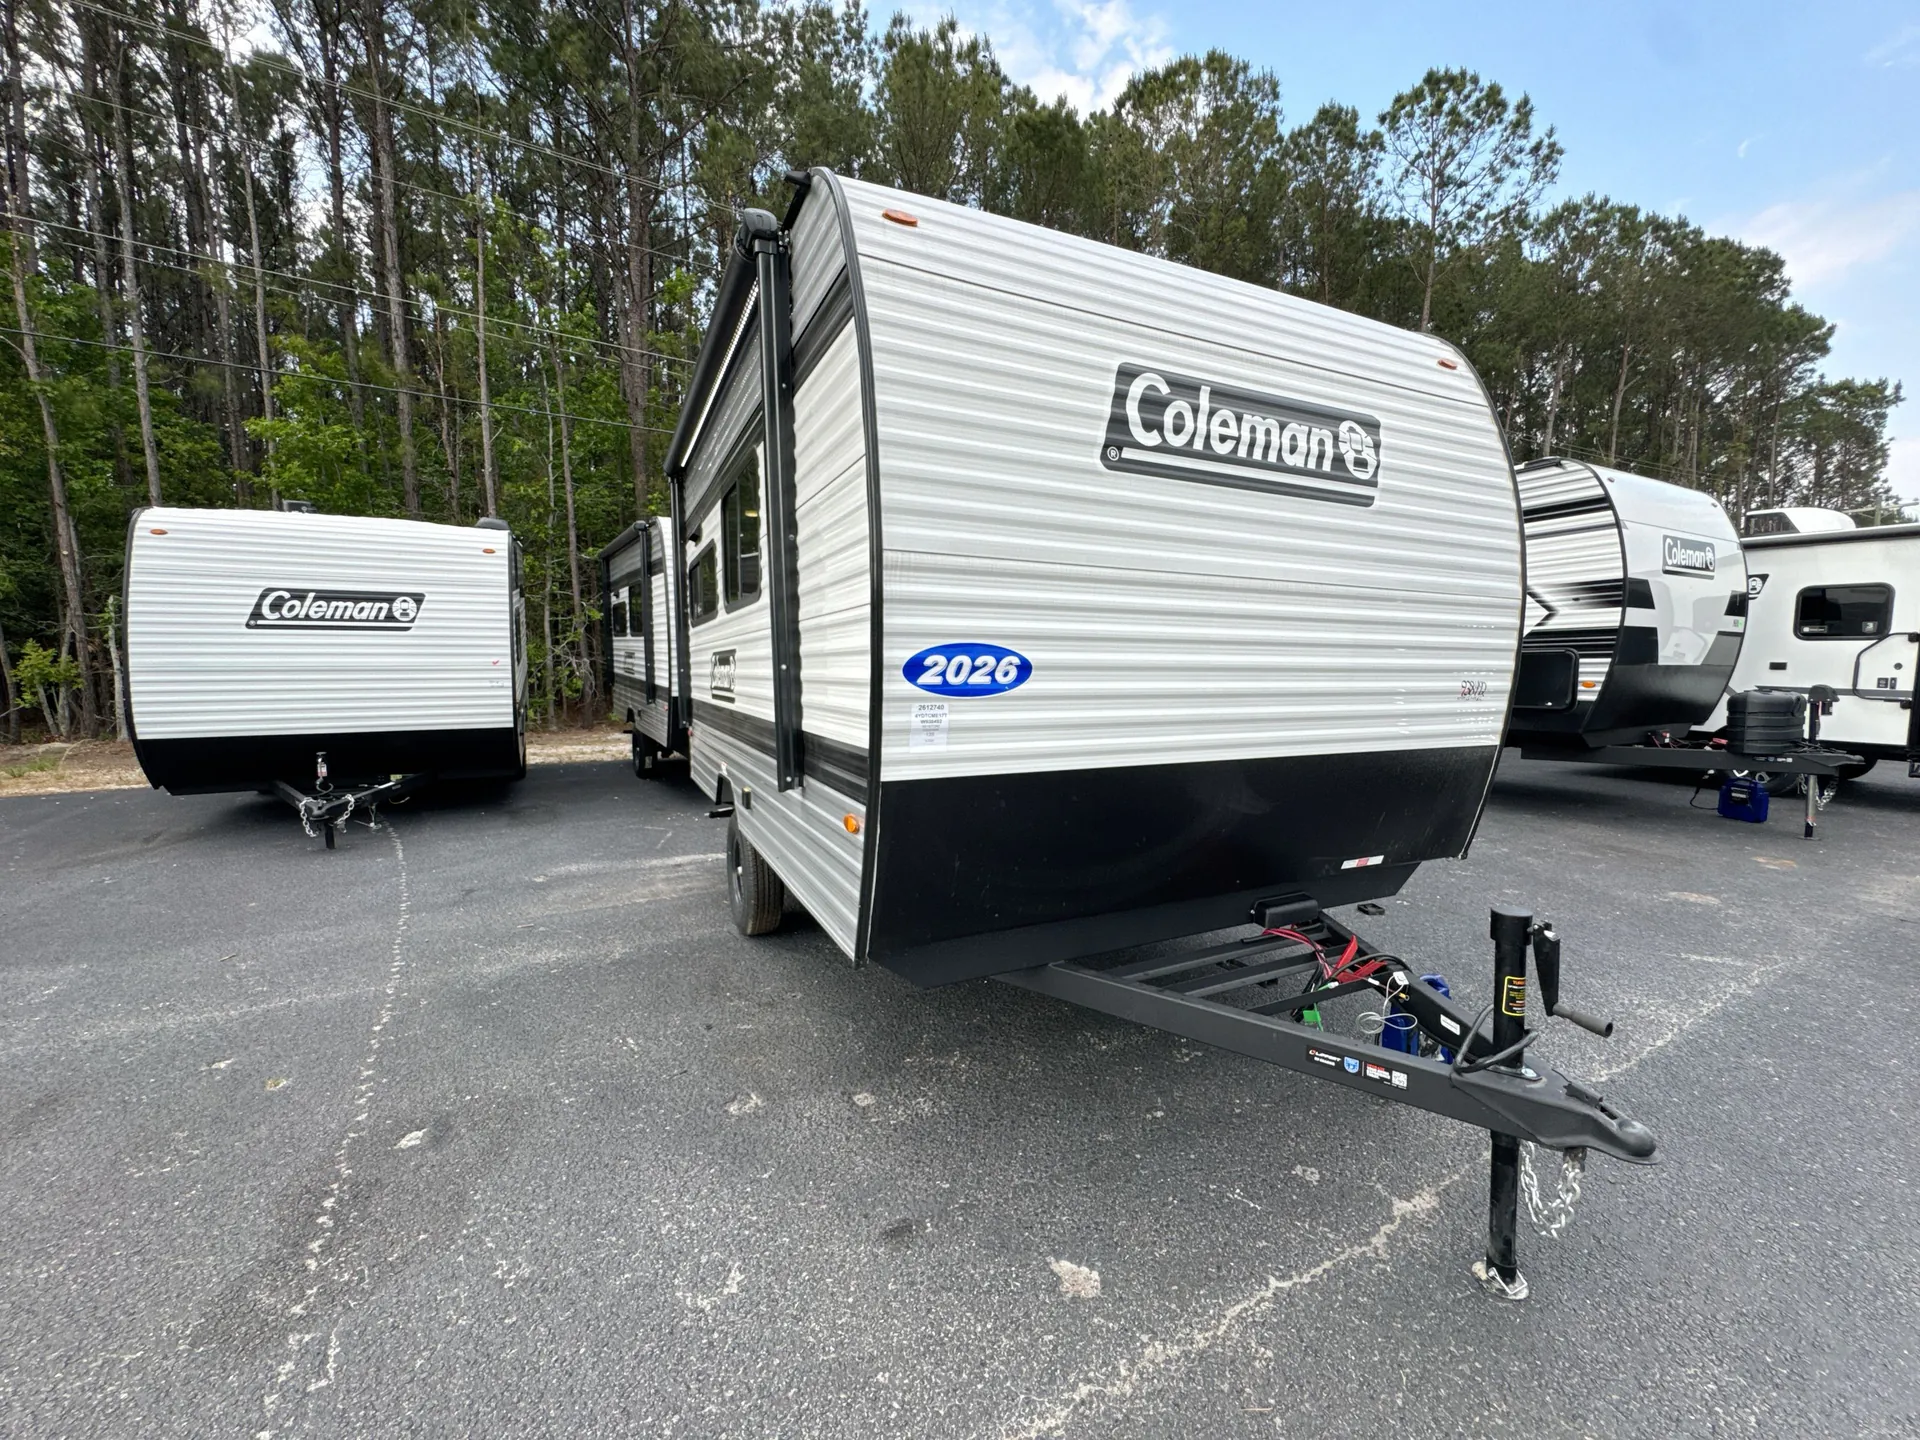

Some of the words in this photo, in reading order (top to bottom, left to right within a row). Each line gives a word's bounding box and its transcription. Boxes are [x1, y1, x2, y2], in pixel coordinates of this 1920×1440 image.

[1125, 372, 1334, 472] Coleman
[1665, 537, 1706, 569] Coleman
[261, 590, 389, 620] Coleman
[916, 654, 1022, 686] 2026
